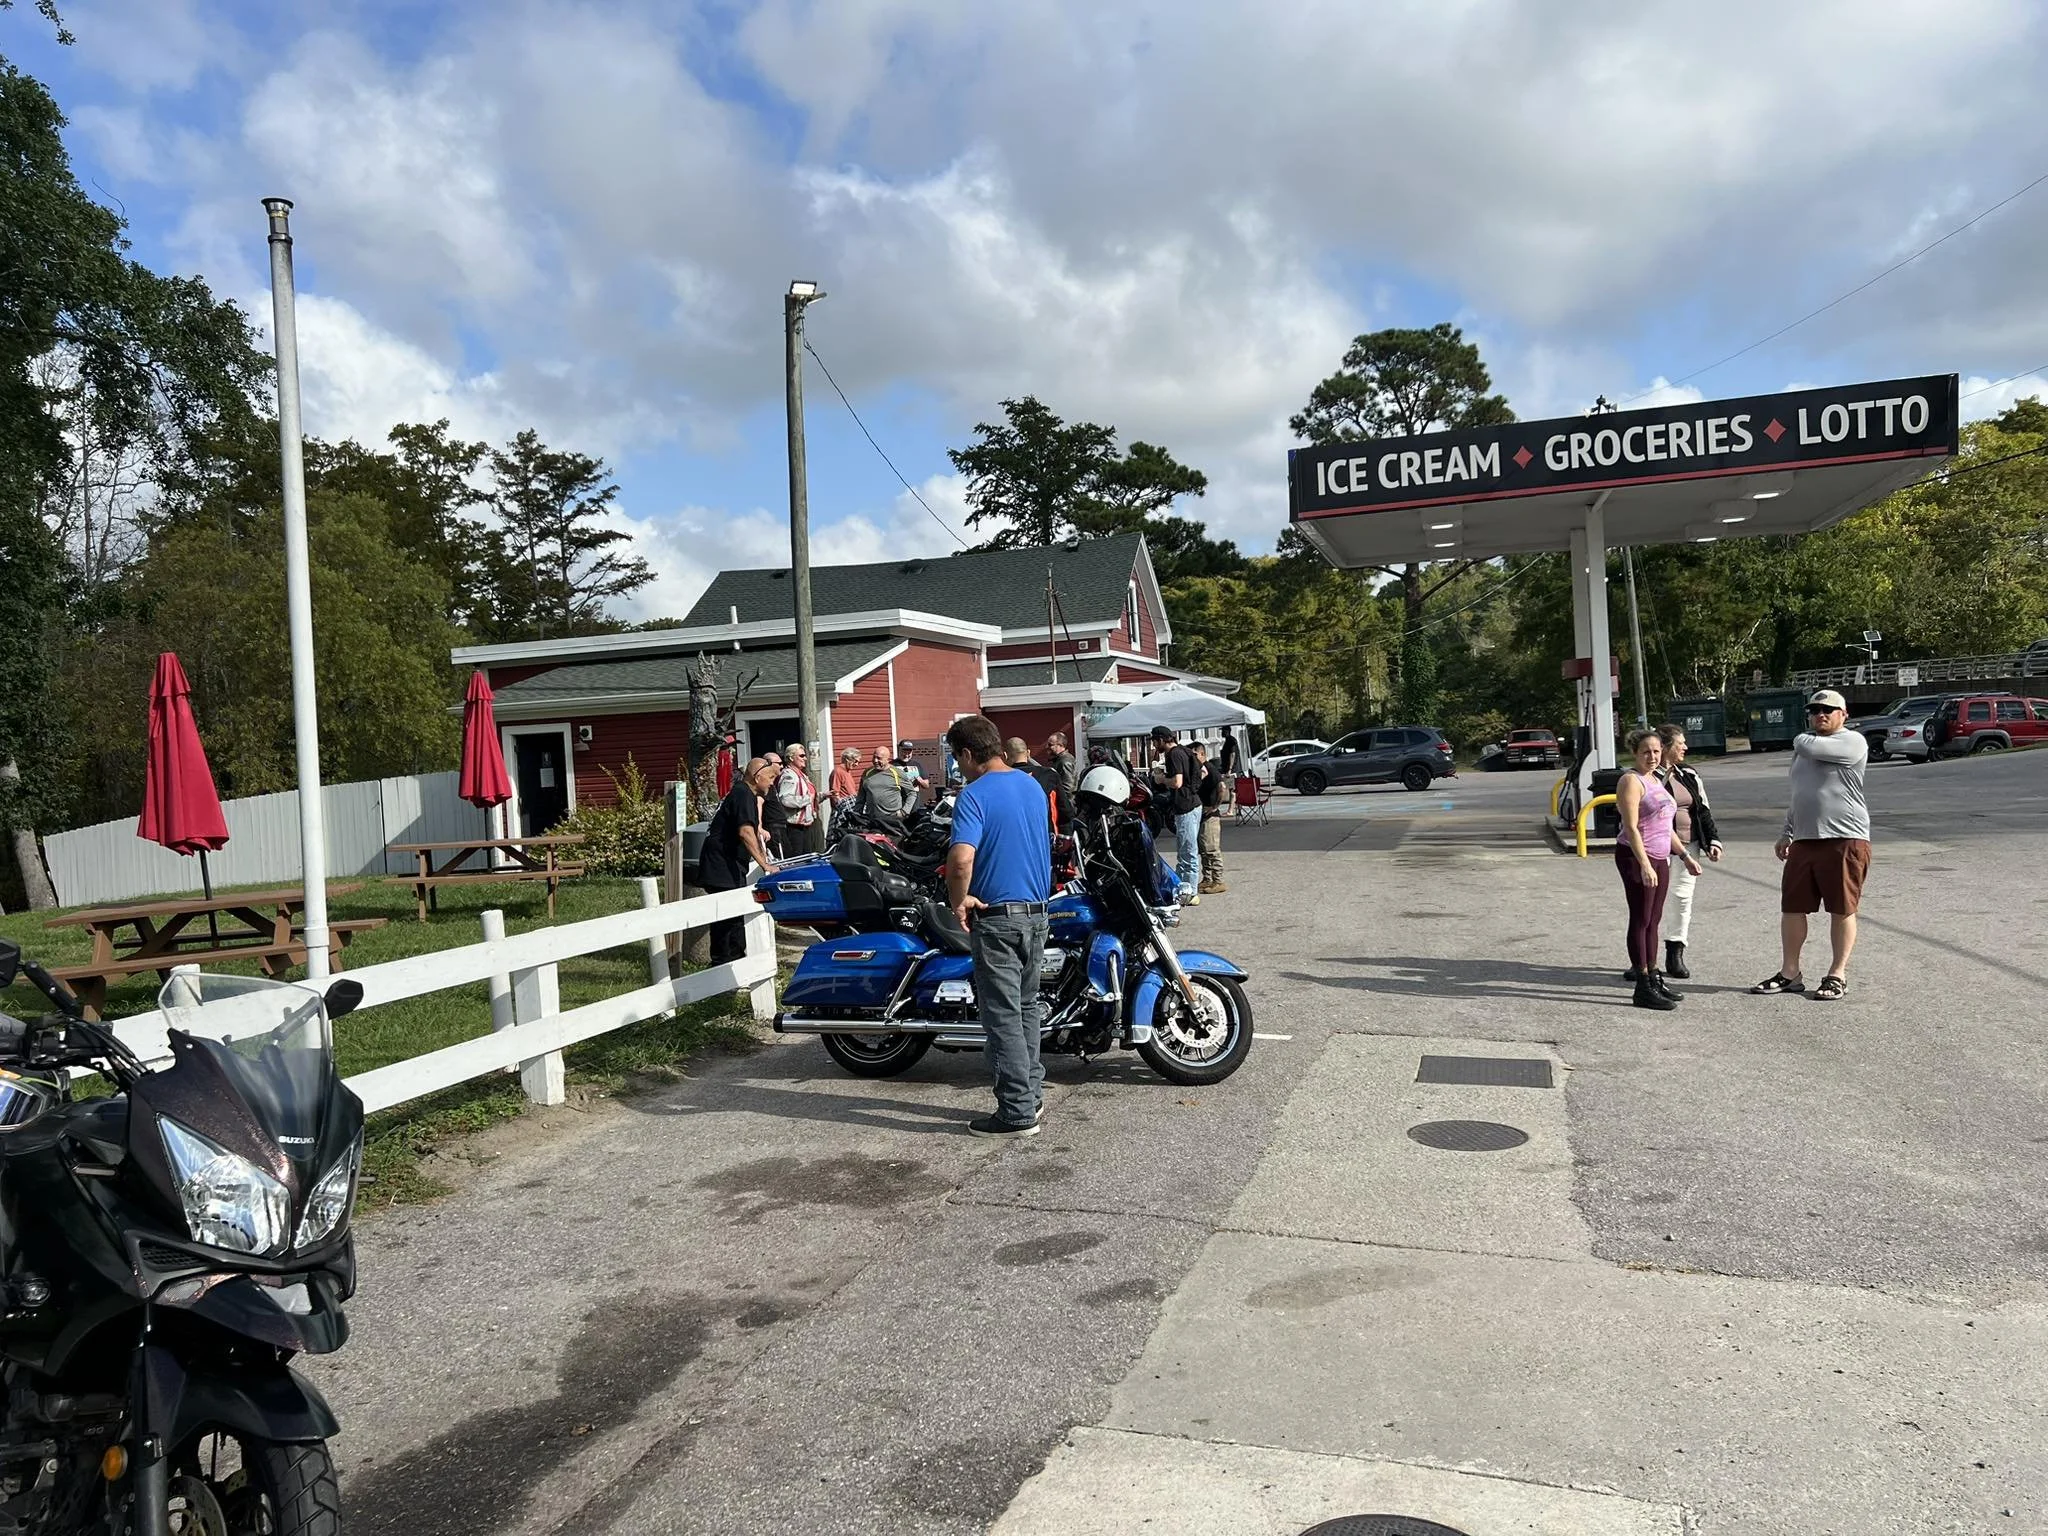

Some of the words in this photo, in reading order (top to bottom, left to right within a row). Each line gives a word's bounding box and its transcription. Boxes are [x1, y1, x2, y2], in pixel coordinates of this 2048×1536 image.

[1317, 457, 1368, 496] ICE
[1378, 442, 1500, 489] CREAM
[1544, 414, 1753, 471] GROCERIES
[1798, 395, 1929, 445] LOTTO
[279, 1135, 315, 1144] SUZUKI
